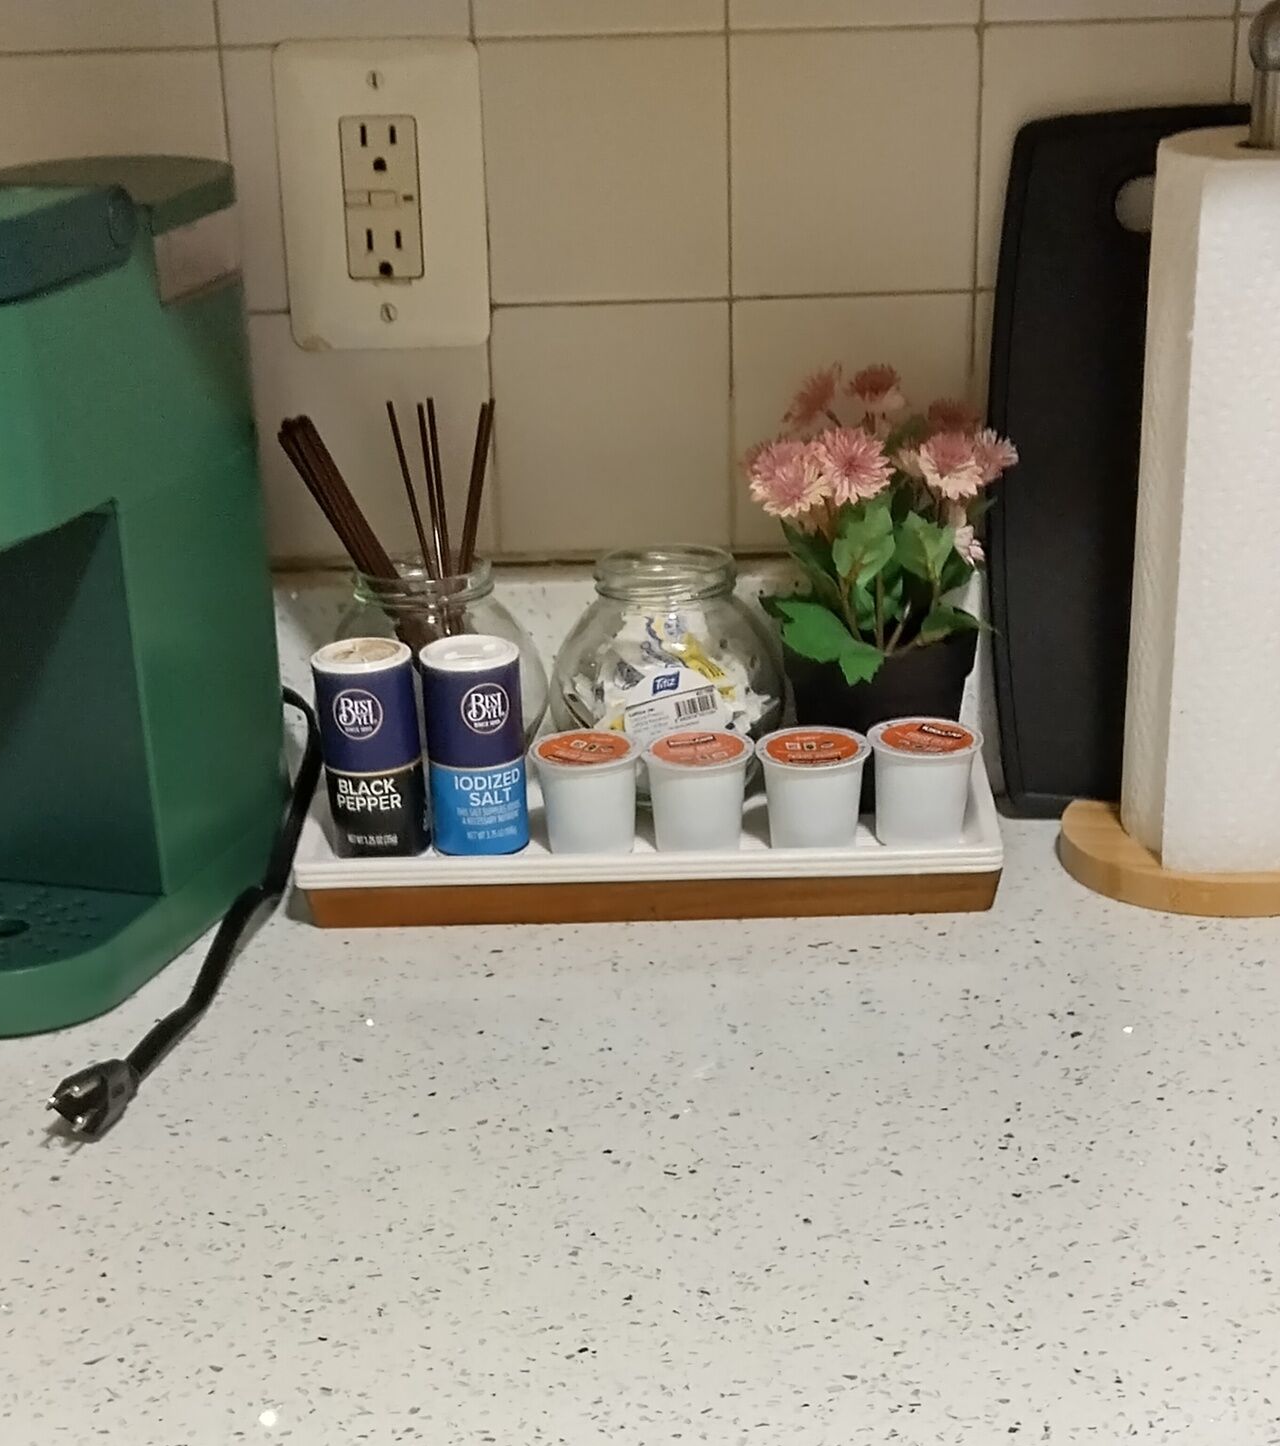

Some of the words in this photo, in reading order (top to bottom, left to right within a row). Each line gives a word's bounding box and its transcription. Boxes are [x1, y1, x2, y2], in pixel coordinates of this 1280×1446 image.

[338, 778, 396, 796] BLACK
[454, 768, 520, 791] IODIZED
[337, 793, 402, 812] PEPPER
[469, 787, 512, 807] SALT
